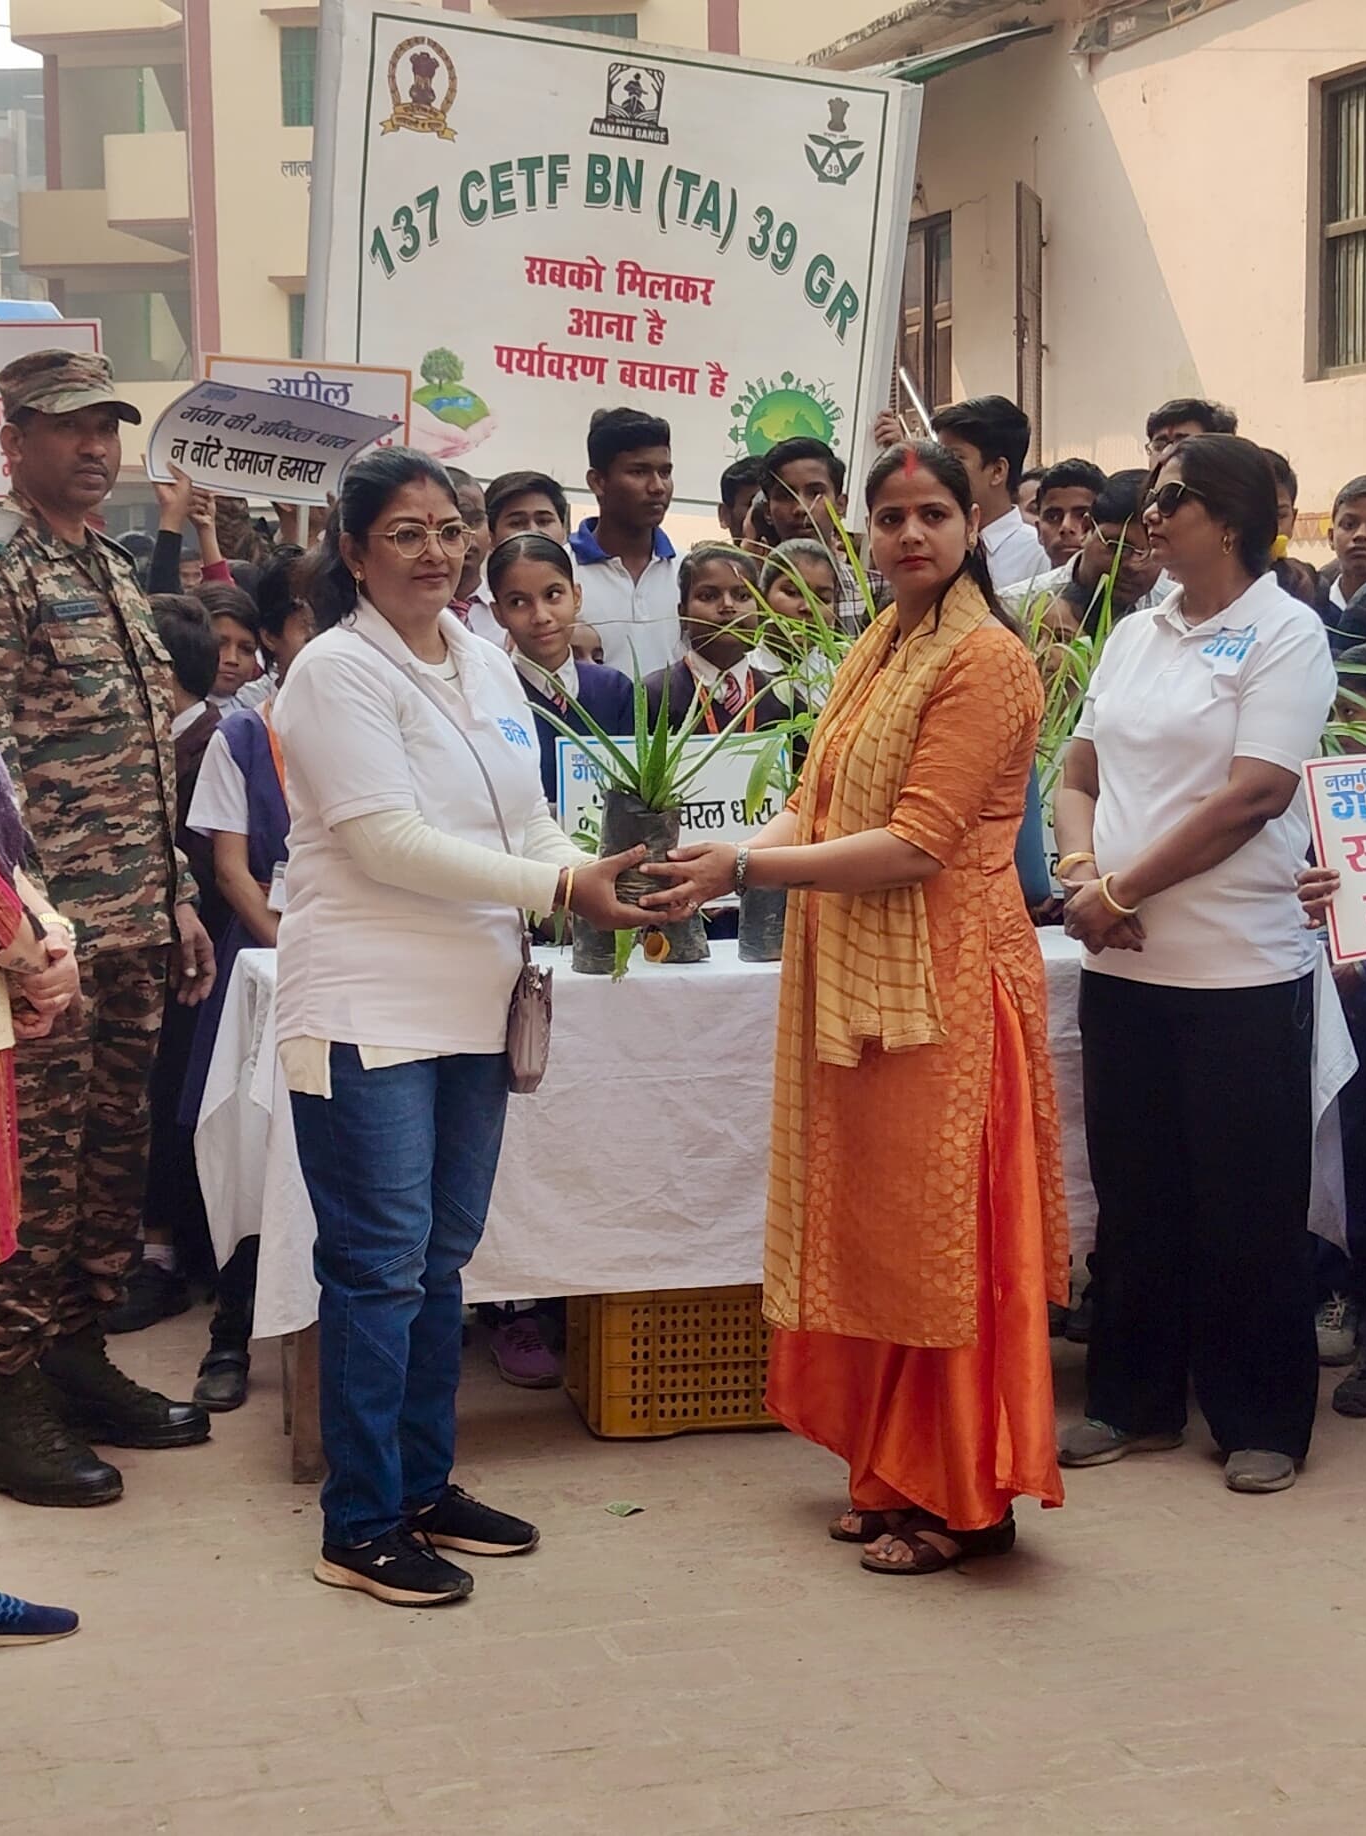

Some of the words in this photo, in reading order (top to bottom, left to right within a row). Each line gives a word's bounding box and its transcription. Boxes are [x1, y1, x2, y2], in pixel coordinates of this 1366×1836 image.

[593, 121, 633, 137] NAMAMI
[635, 127, 667, 142] GANGE
[826, 164, 840, 174] 39
[370, 185, 440, 278] 137
[460, 154, 570, 226] CETF
[585, 153, 644, 211] BN
[658, 164, 738, 254] (TA)
[748, 205, 797, 274] 39
[804, 253, 860, 344] GR
[524, 255, 606, 293] सबको
[615, 260, 715, 306] मिलकर
[567, 308, 637, 342] आना
[643, 308, 667, 346] है
[267, 371, 353, 406] अपील
[494, 342, 608, 386] पर्यावरण
[617, 359, 699, 395] बचाना
[706, 360, 729, 397] है
[180, 404, 226, 426] गंगा
[223, 412, 253, 433] की
[251, 420, 318, 444] अविरल
[170, 438, 190, 465] न
[224, 446, 278, 479] समाज
[277, 455, 327, 485] हमारा
